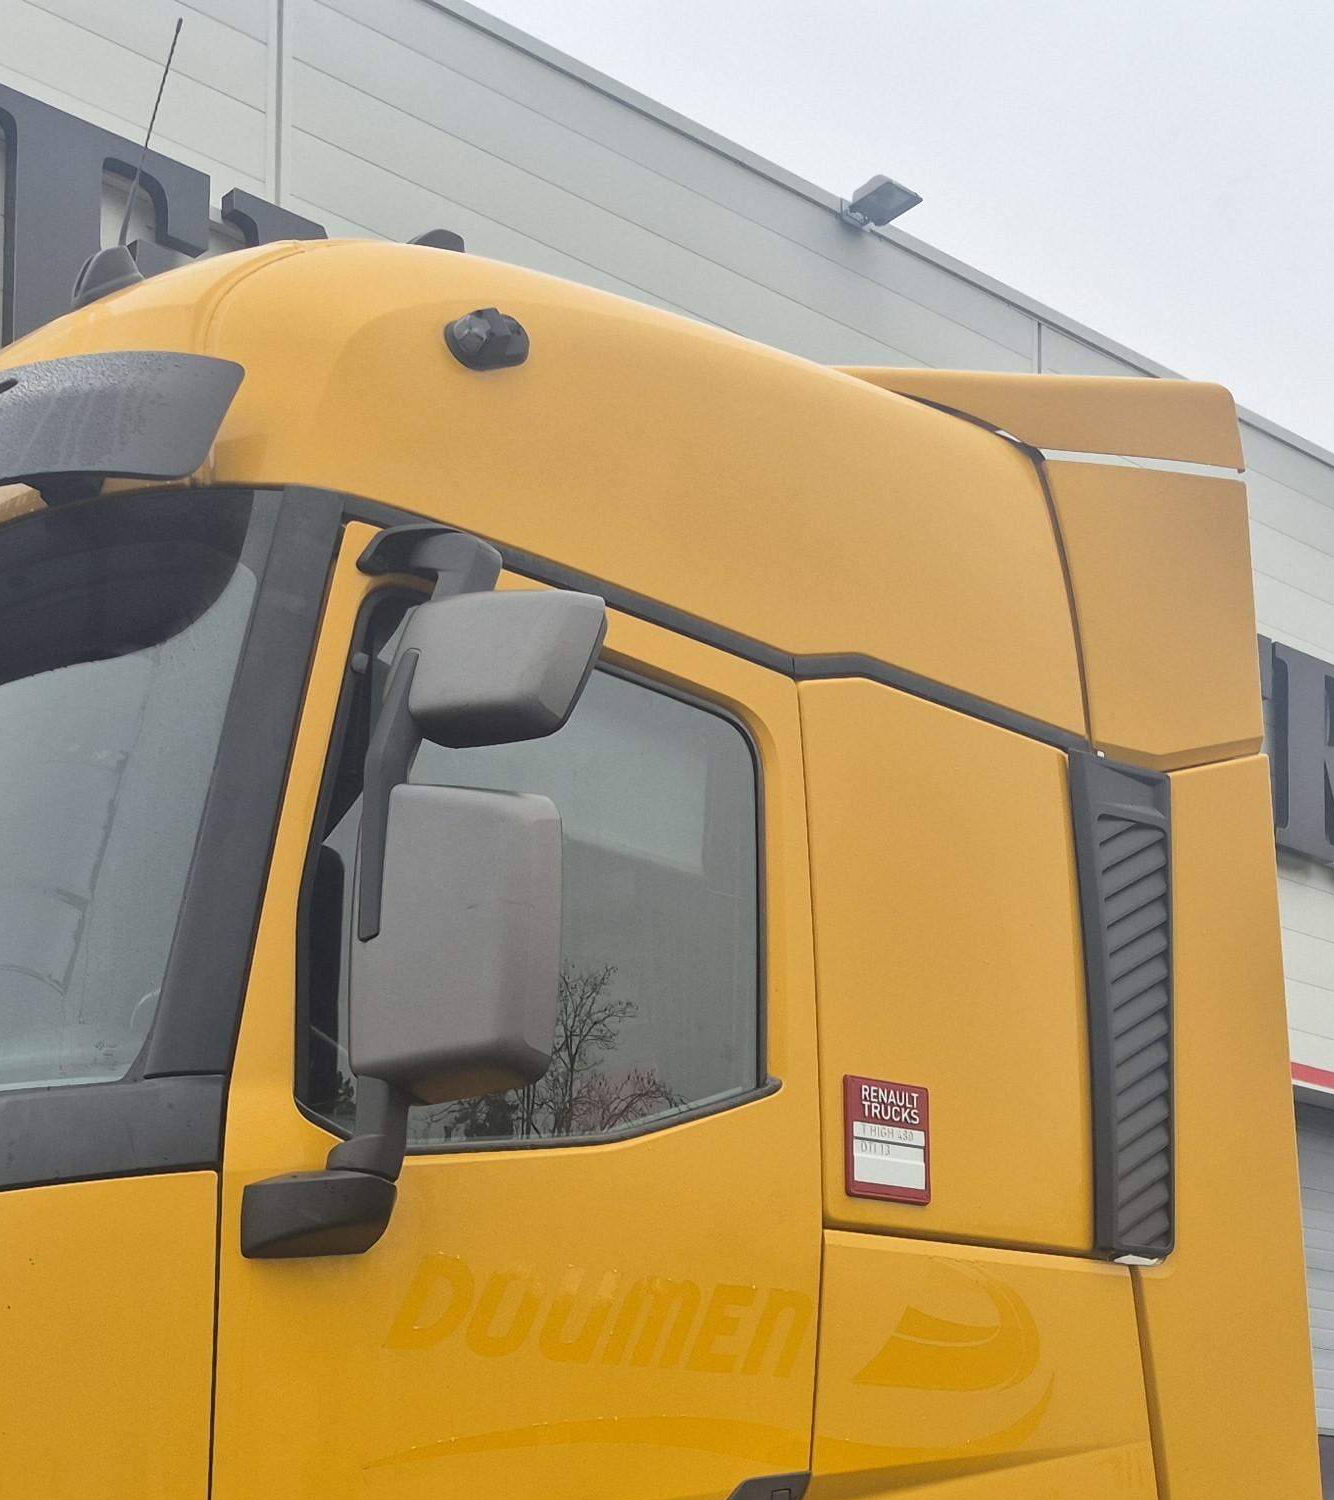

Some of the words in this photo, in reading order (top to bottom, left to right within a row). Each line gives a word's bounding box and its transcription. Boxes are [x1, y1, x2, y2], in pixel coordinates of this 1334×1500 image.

[861, 1085, 919, 1109] RENAULT
[862, 1101, 920, 1125] TRUCKS
[870, 1125, 894, 1139] HIGH
